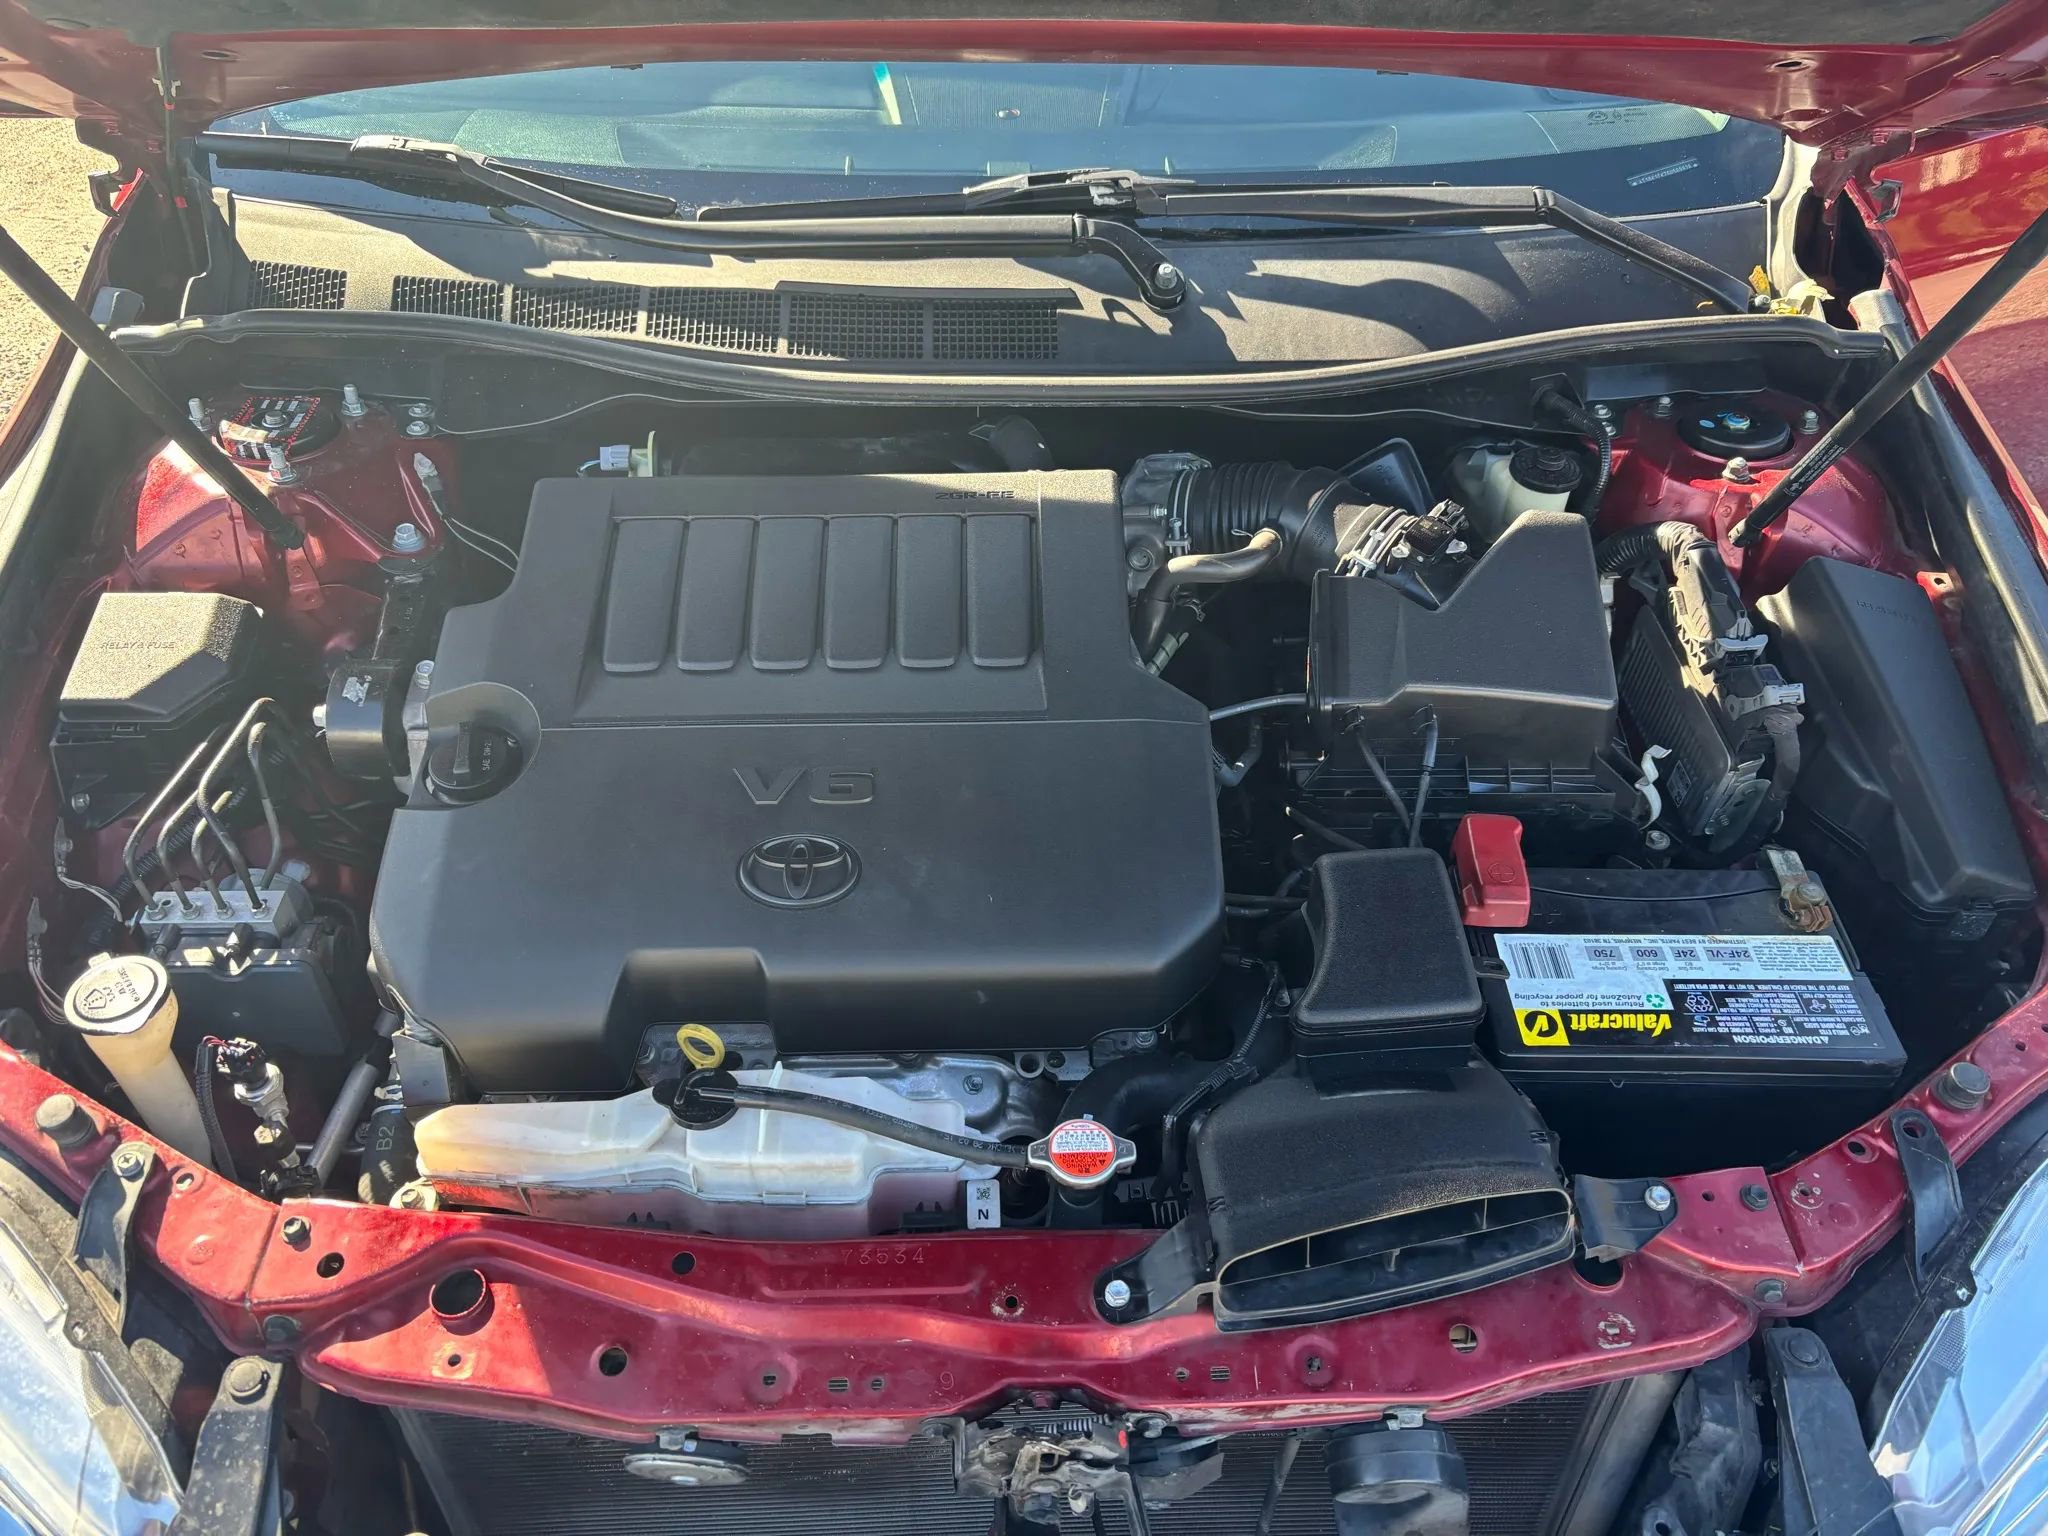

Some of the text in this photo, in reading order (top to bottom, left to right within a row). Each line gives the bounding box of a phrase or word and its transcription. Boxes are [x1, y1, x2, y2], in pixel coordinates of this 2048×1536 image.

[936, 490, 1014, 500] 2GR-FE
[100, 641, 138, 649] RELAY
[146, 641, 176, 649] FUSE
[482, 759, 491, 771] SAE
[732, 768, 875, 805] V6
[1594, 950, 1616, 958] 750
[1636, 950, 1658, 958] 600
[1674, 950, 1696, 958] 24F
[1706, 950, 1750, 958] 24F-VL
[1514, 993, 1553, 1001] recycling
[1570, 1013, 1672, 1038] Valucraft
[1732, 1035, 1820, 1044] DANGER/POISON
[376, 1126, 395, 1151] B2
[978, 1209, 989, 1220] N
